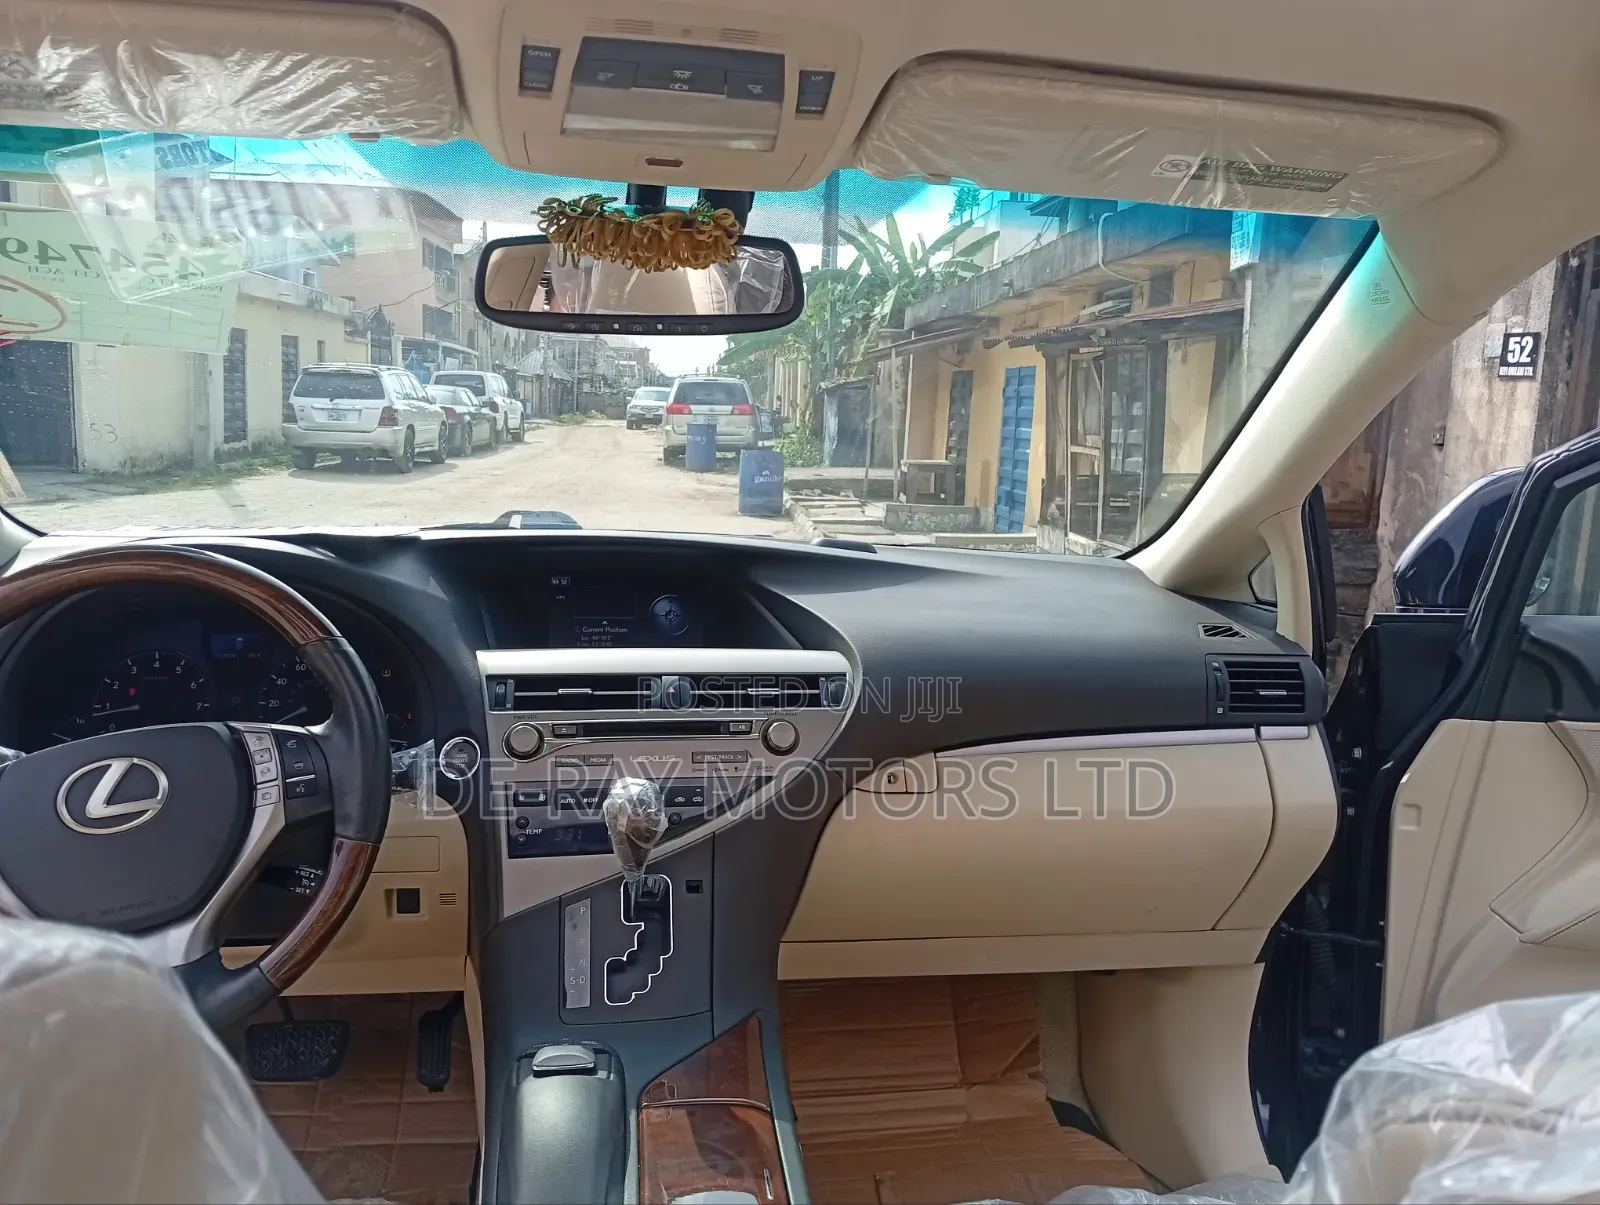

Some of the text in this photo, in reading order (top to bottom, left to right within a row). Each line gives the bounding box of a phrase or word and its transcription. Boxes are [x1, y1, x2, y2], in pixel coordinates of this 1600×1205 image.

[527, 49, 552, 58] OPEN
[1232, 160, 1265, 172] BAG
[1270, 165, 1345, 180] WARNING
[1507, 335, 1534, 364] 52
[88, 422, 118, 444] 53
[130, 666, 138, 674] 3
[175, 666, 182, 674] 5
[295, 663, 307, 671] 60
[112, 681, 119, 689] 2
[105, 702, 110, 710] 1
[196, 702, 202, 710] 7
[268, 699, 280, 707] 20
[109, 723, 116, 731] 0
[629, 755, 676, 763] LEXUS
[579, 958, 586, 966] N
